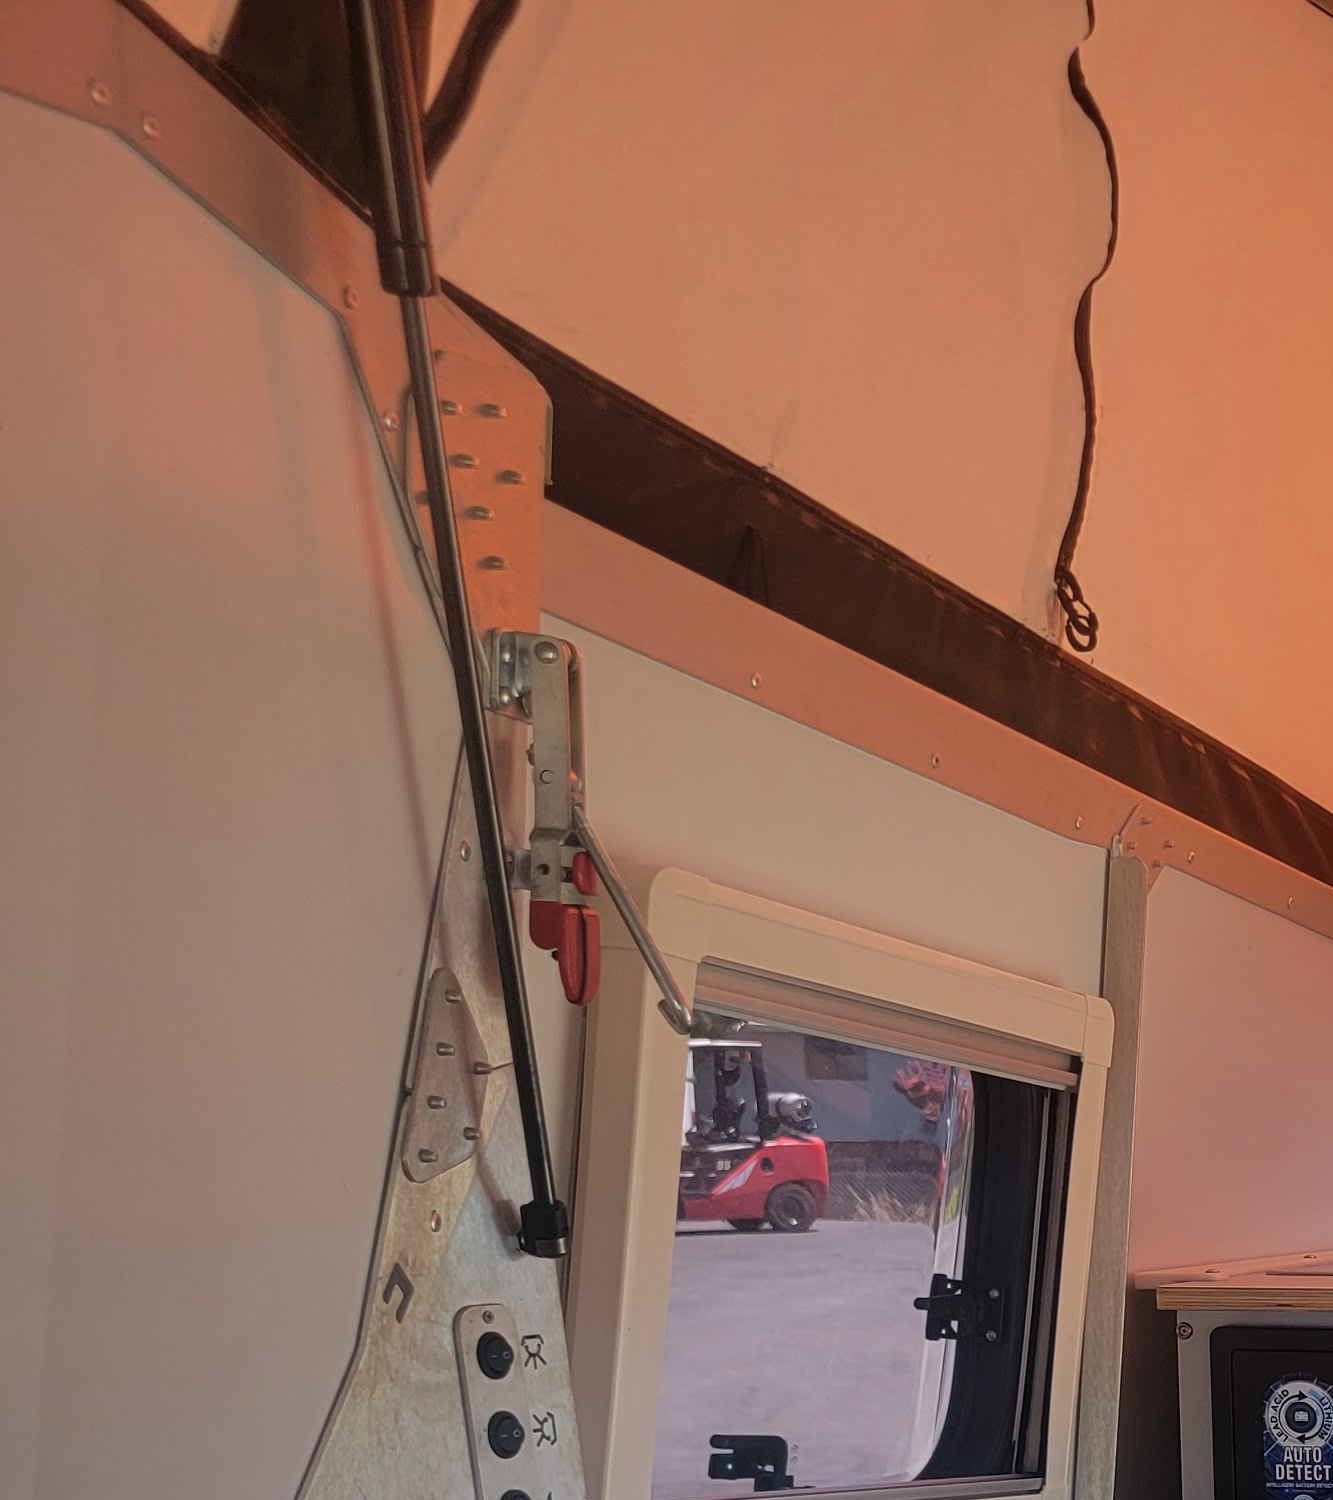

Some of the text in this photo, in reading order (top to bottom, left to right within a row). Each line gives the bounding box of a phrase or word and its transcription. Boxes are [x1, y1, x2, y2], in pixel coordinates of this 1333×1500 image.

[1270, 1389, 1289, 1442] LEAD ACID
[1318, 1396, 1333, 1440] LITHIUM
[1283, 1446, 1322, 1463] AUTO
[1275, 1464, 1331, 1481] DETECT
